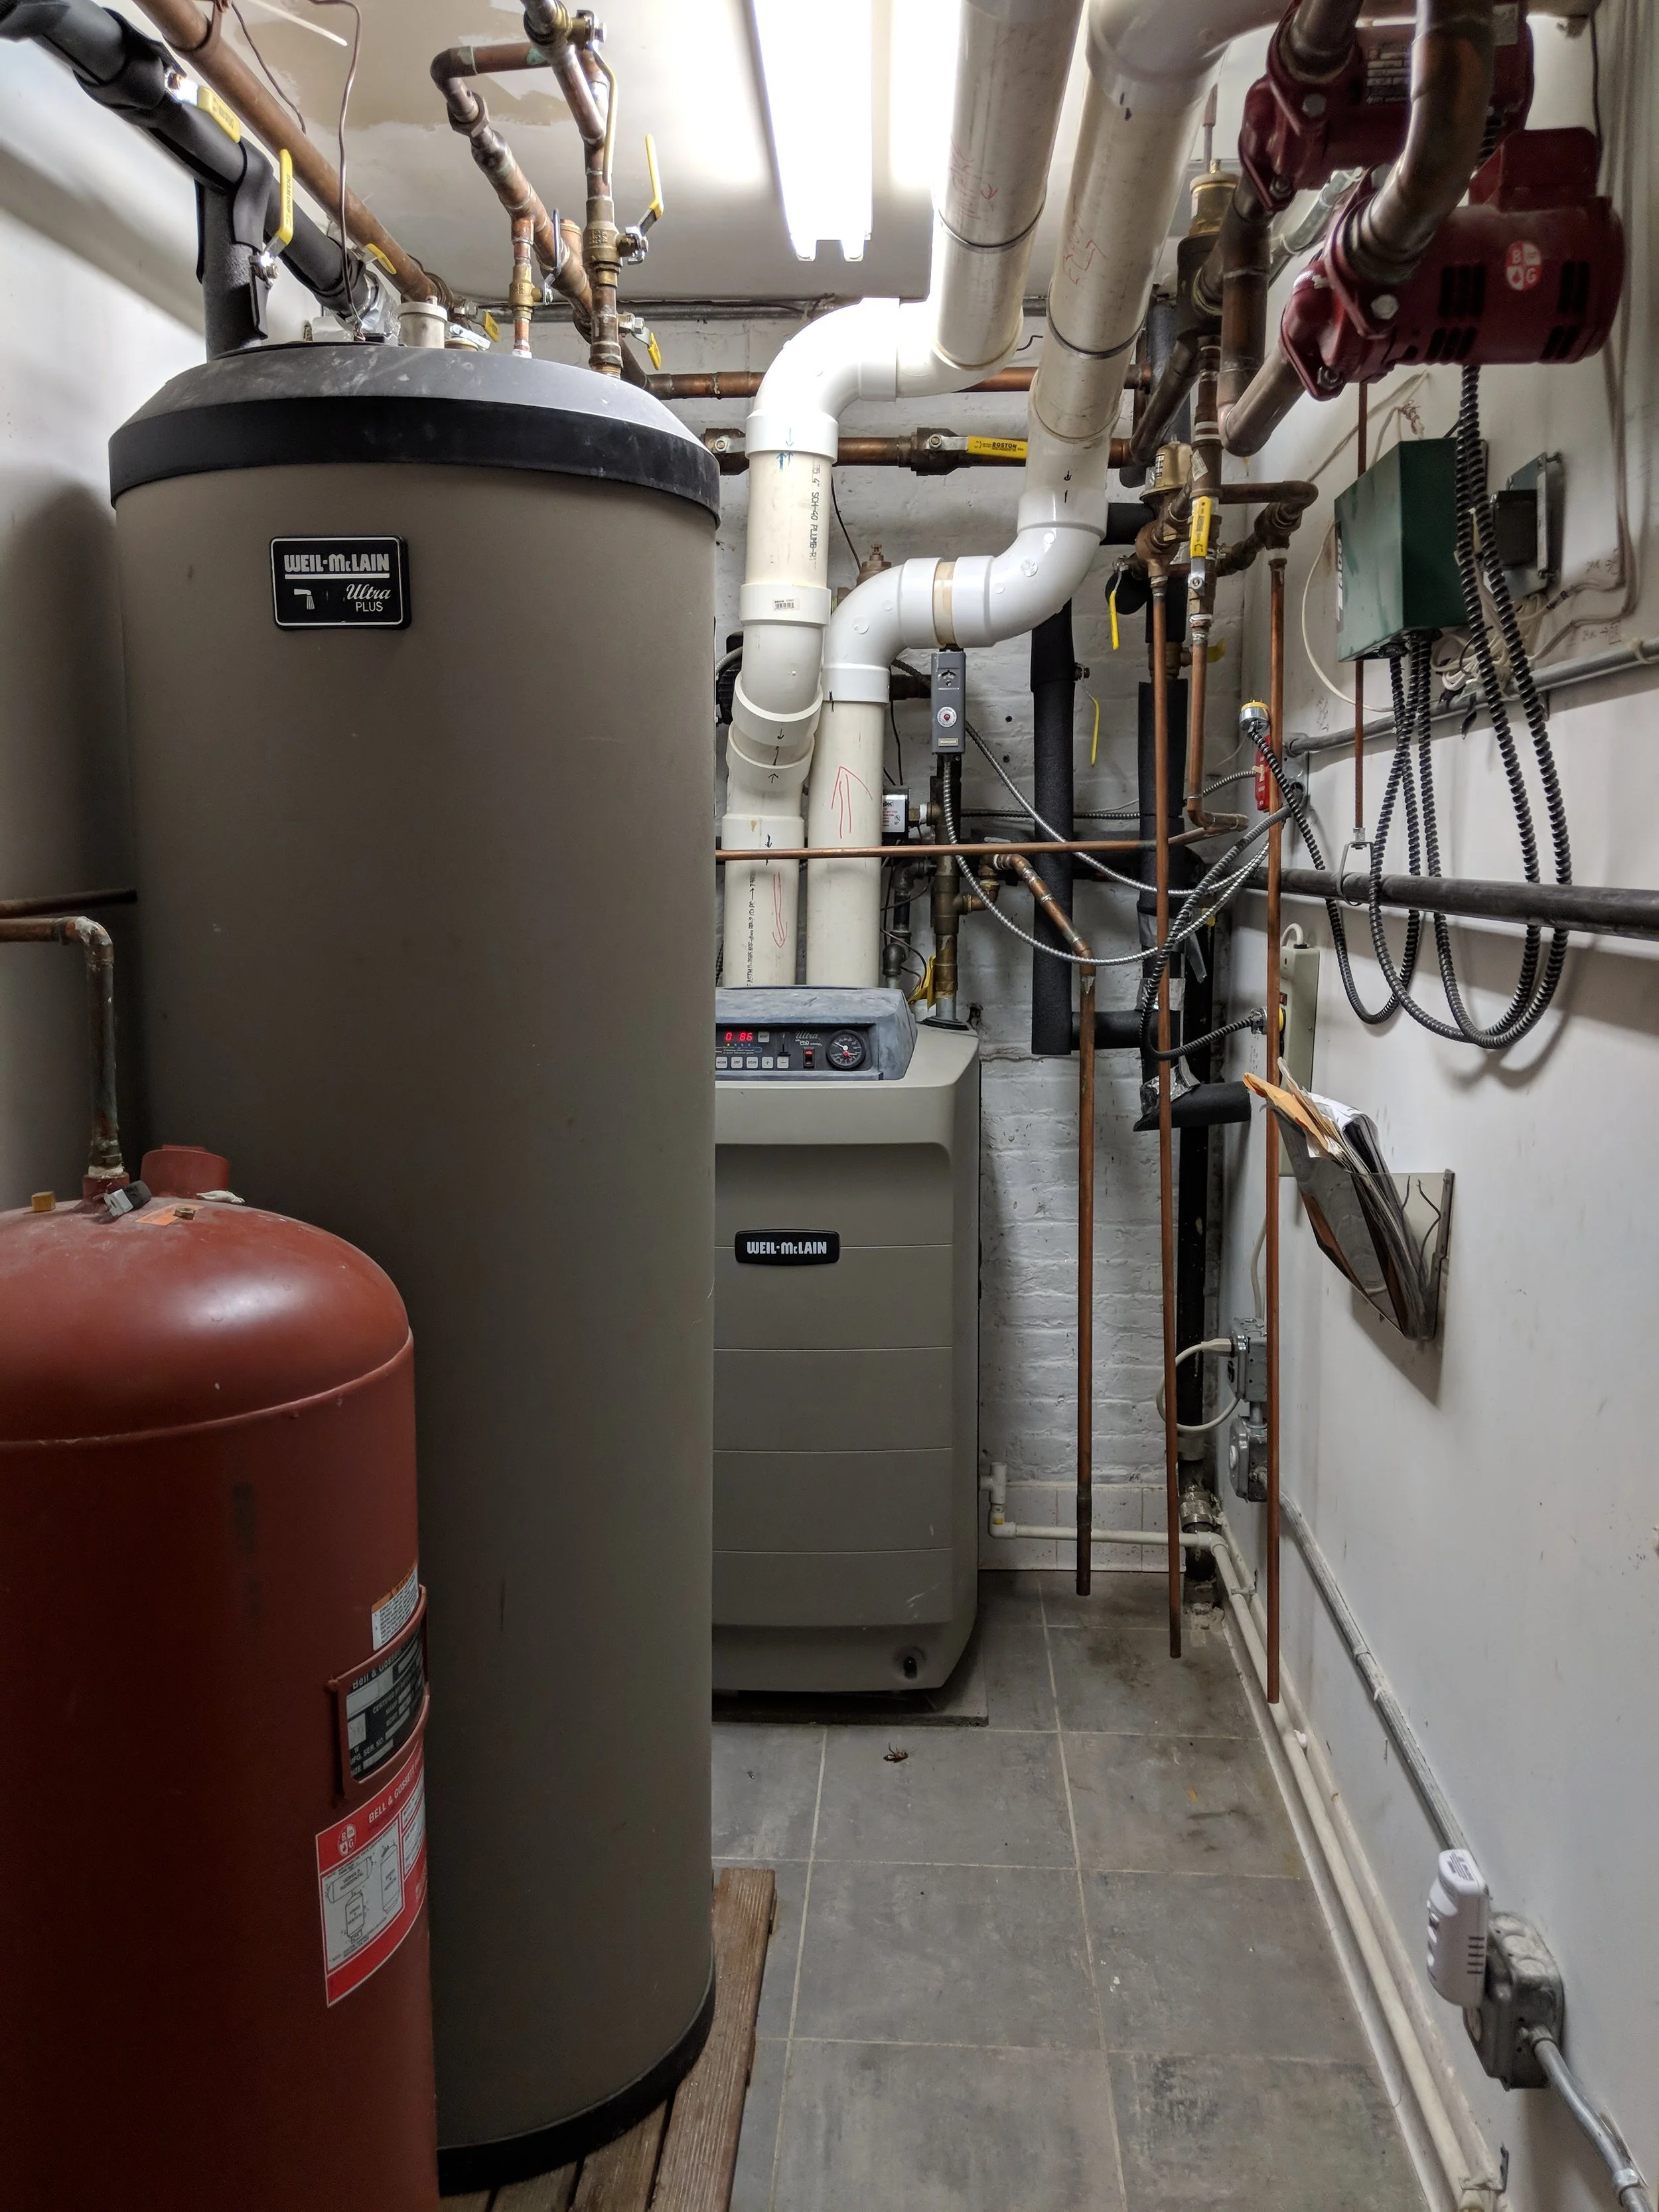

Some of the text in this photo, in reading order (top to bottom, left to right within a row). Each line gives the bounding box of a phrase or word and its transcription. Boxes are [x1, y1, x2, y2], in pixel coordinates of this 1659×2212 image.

[810, 492, 820, 520] SCH-40
[346, 583, 391, 600] Ultra
[356, 601, 384, 612] PLUS
[368, 1803, 387, 1824] BELL
